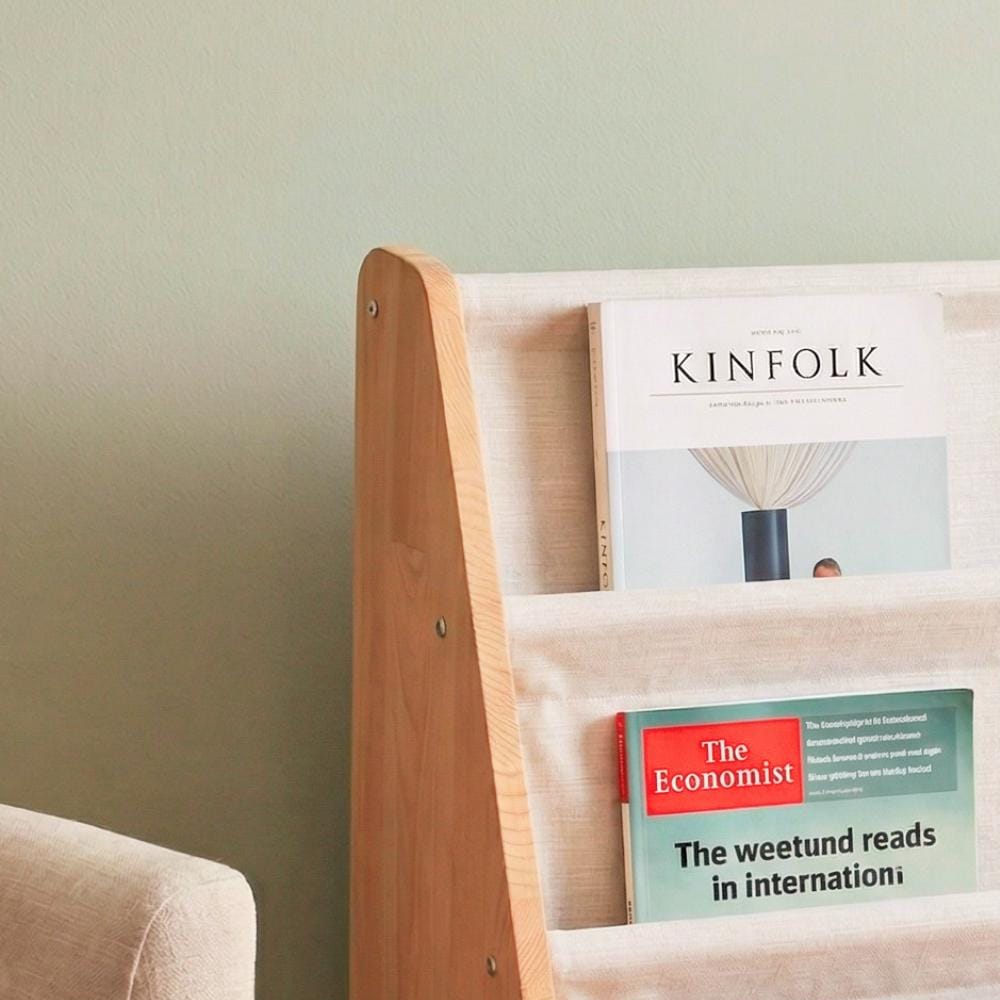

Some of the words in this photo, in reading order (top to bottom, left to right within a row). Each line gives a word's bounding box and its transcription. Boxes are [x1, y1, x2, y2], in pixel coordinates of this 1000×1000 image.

[671, 346, 883, 383] KINFOLK
[701, 739, 748, 764] The
[654, 761, 795, 794] Economist
[674, 838, 727, 868] The
[734, 827, 854, 863] weetund
[862, 821, 937, 853] reads
[712, 873, 737, 901] in
